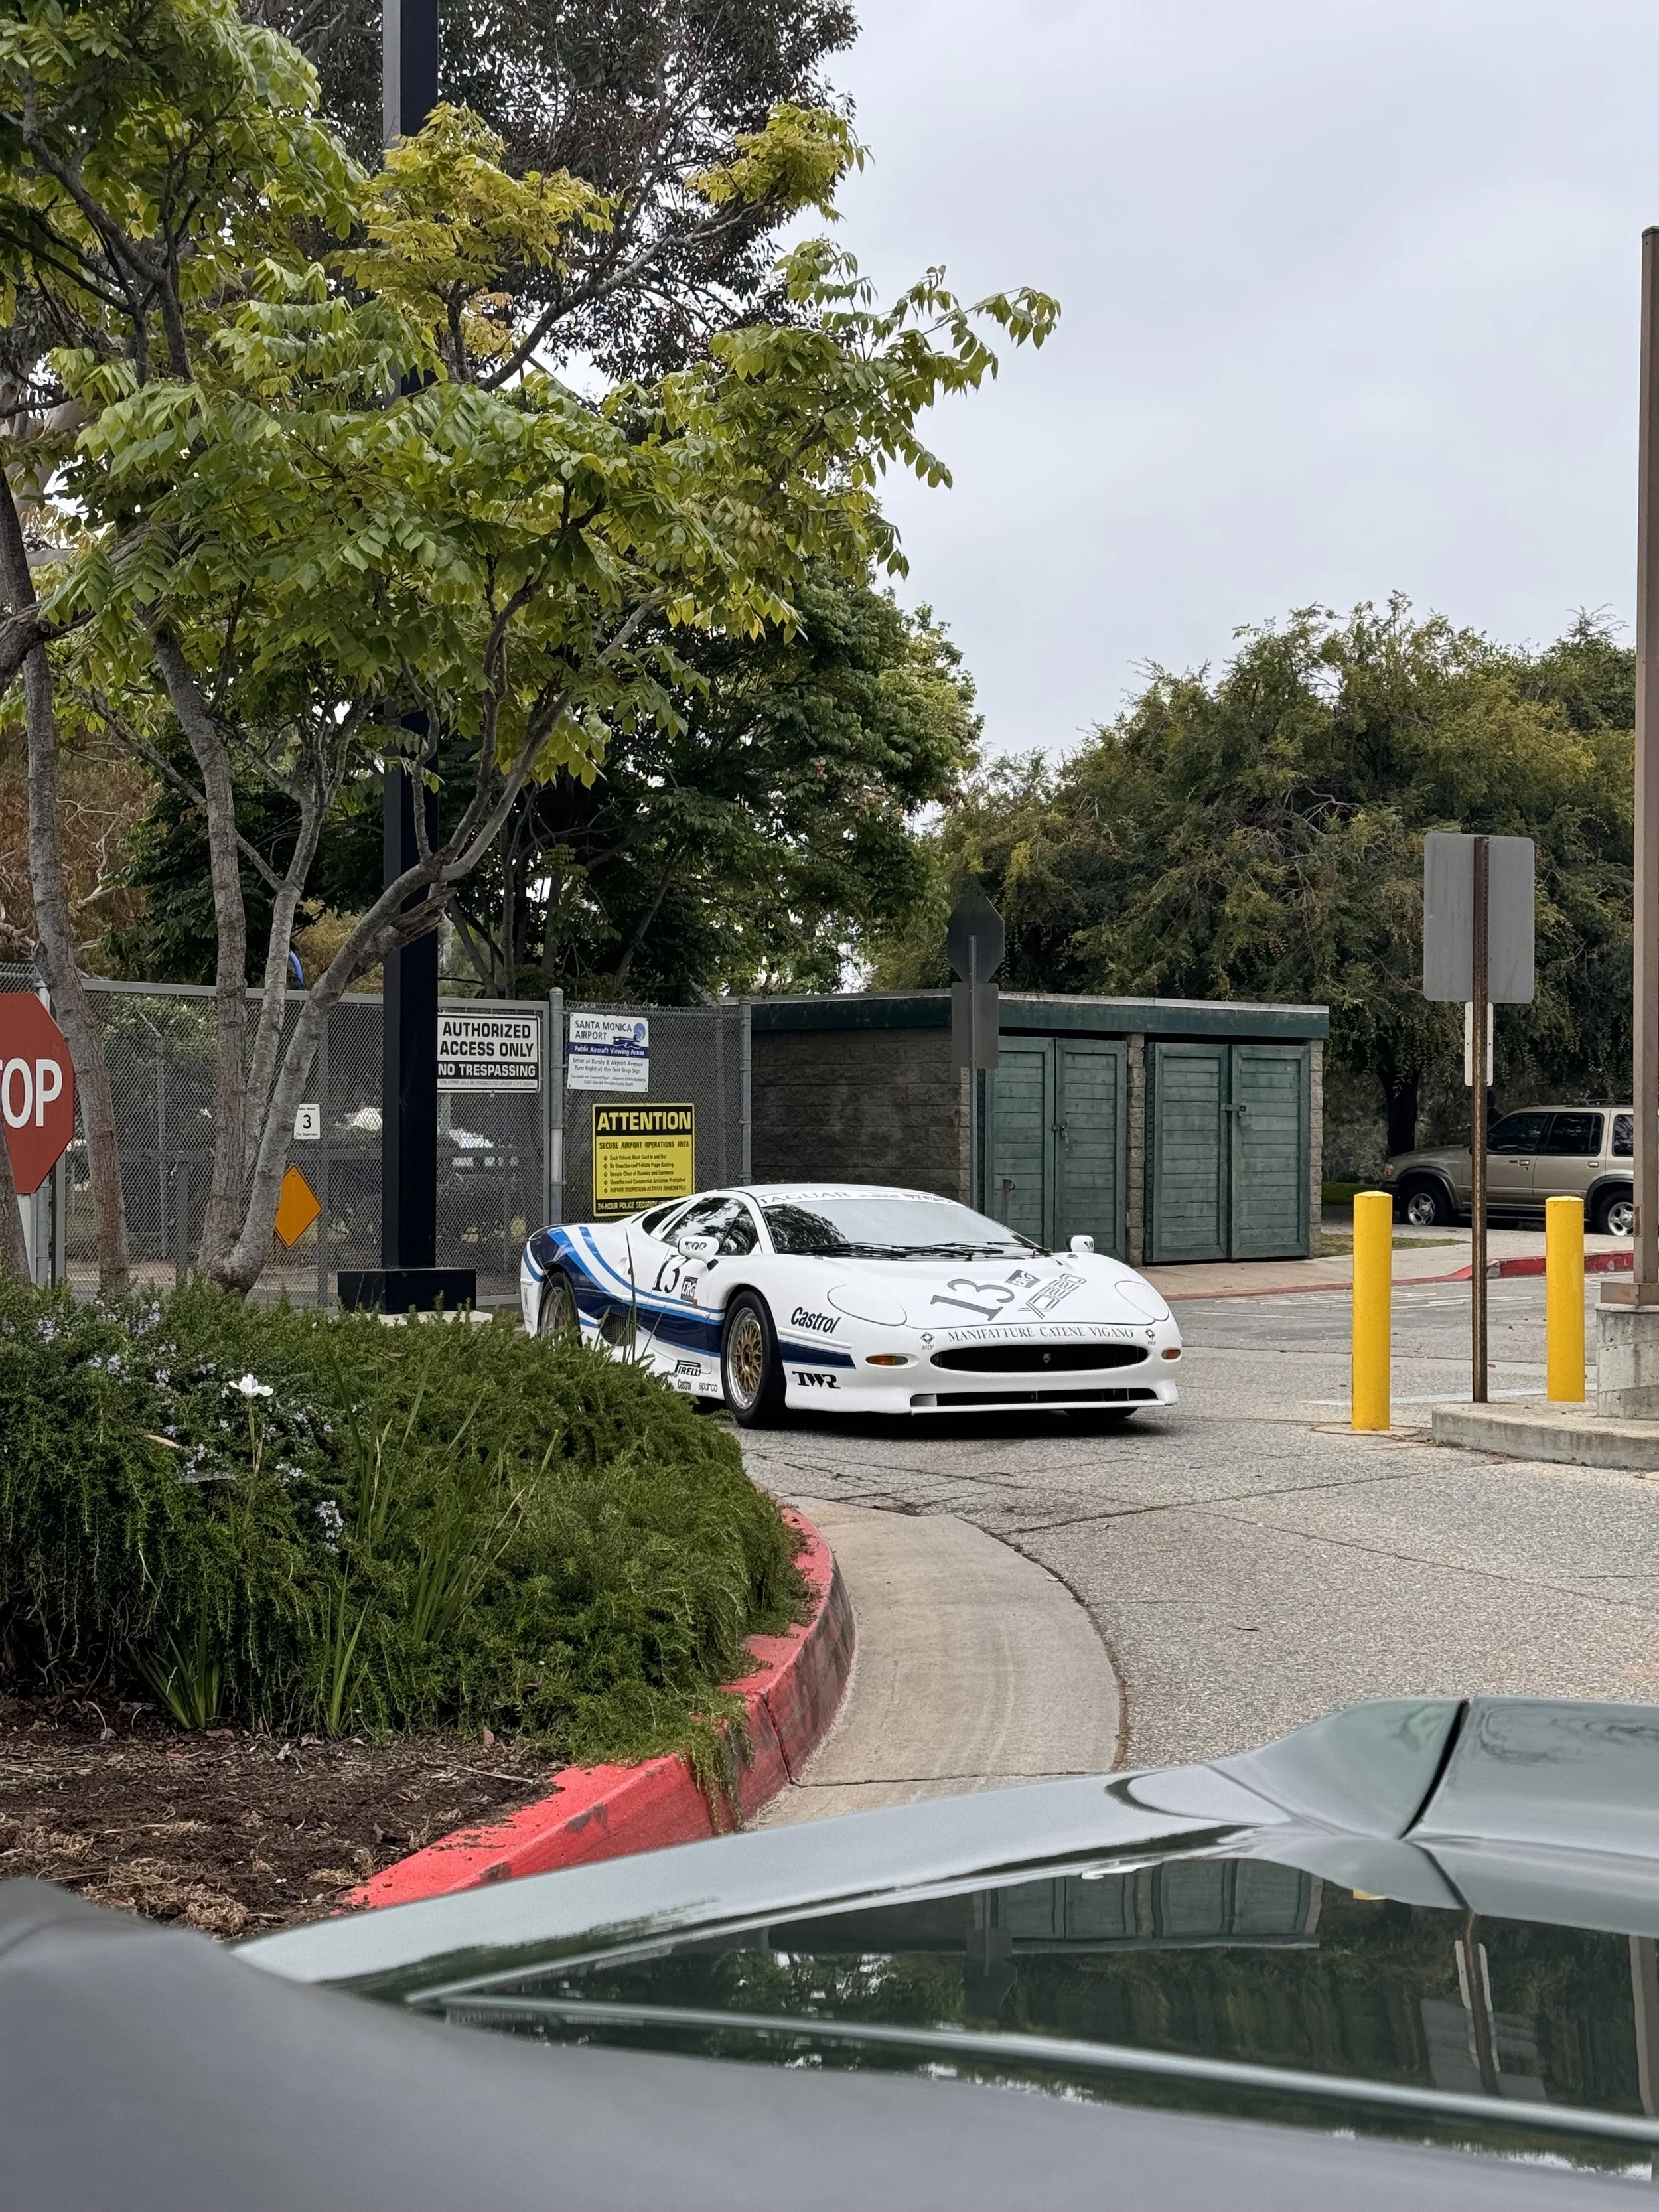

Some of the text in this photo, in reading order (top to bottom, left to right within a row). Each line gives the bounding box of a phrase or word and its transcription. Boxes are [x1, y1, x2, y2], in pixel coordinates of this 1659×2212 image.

[442, 1021, 531, 1039] AUTHORIZED
[575, 1020, 632, 1032] SANTA MONICA
[575, 1031, 607, 1041] AIRPORT
[440, 1041, 534, 1057] ACCESS ONLY
[611, 1047, 630, 1056] Viewing
[438, 1063, 536, 1077] NO TRESPASSING
[0, 1057, 63, 1128] OP
[303, 1114, 311, 1129] 3
[597, 1112, 691, 1130] ATTENTION
[620, 1141, 642, 1149] AIRPORT
[760, 1192, 851, 1203] JAGUAR
[1011, 1271, 1036, 1286] ERG
[682, 1280, 697, 1297] ERG
[930, 1278, 1015, 1321] 13
[791, 1307, 841, 1333] Castrol
[948, 1327, 1035, 1341] MANIFATTURE
[1039, 1327, 1086, 1337] CATENE
[674, 1359, 701, 1376] PIRELLI
[792, 1371, 841, 1389] TWR
